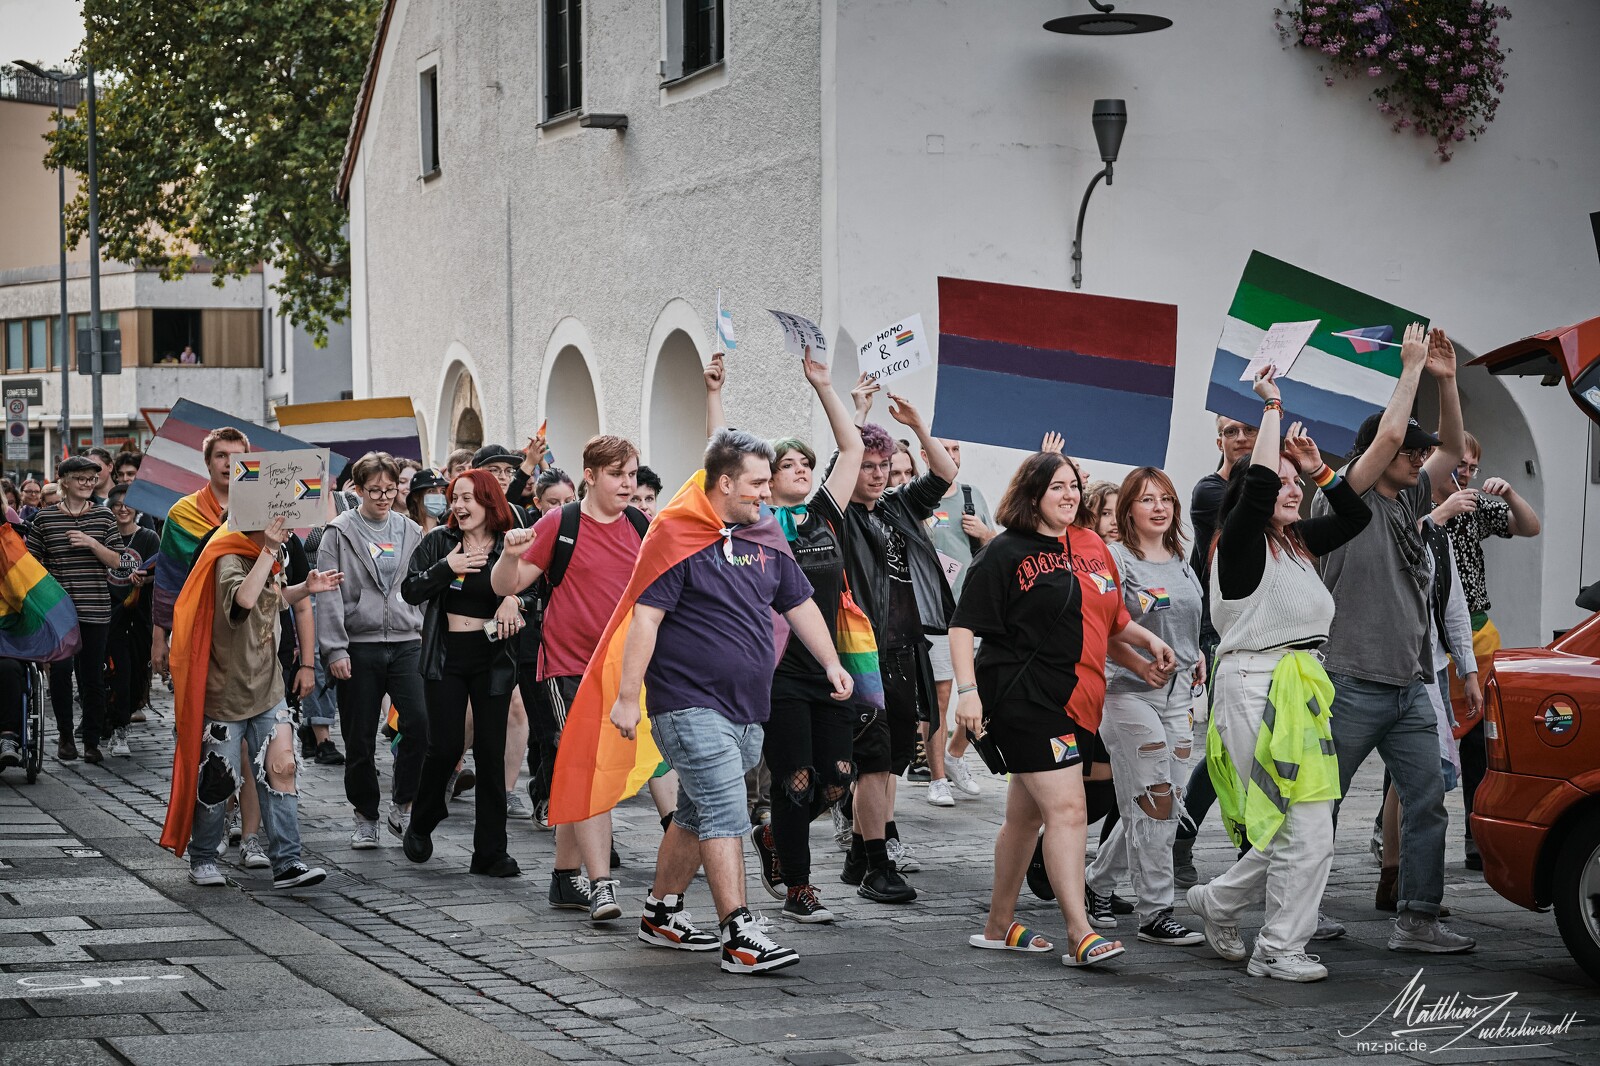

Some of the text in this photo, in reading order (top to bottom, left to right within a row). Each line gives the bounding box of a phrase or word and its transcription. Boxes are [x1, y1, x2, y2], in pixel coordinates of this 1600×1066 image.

[860, 323, 903, 355] PRO HOMO
[879, 343, 891, 360] &
